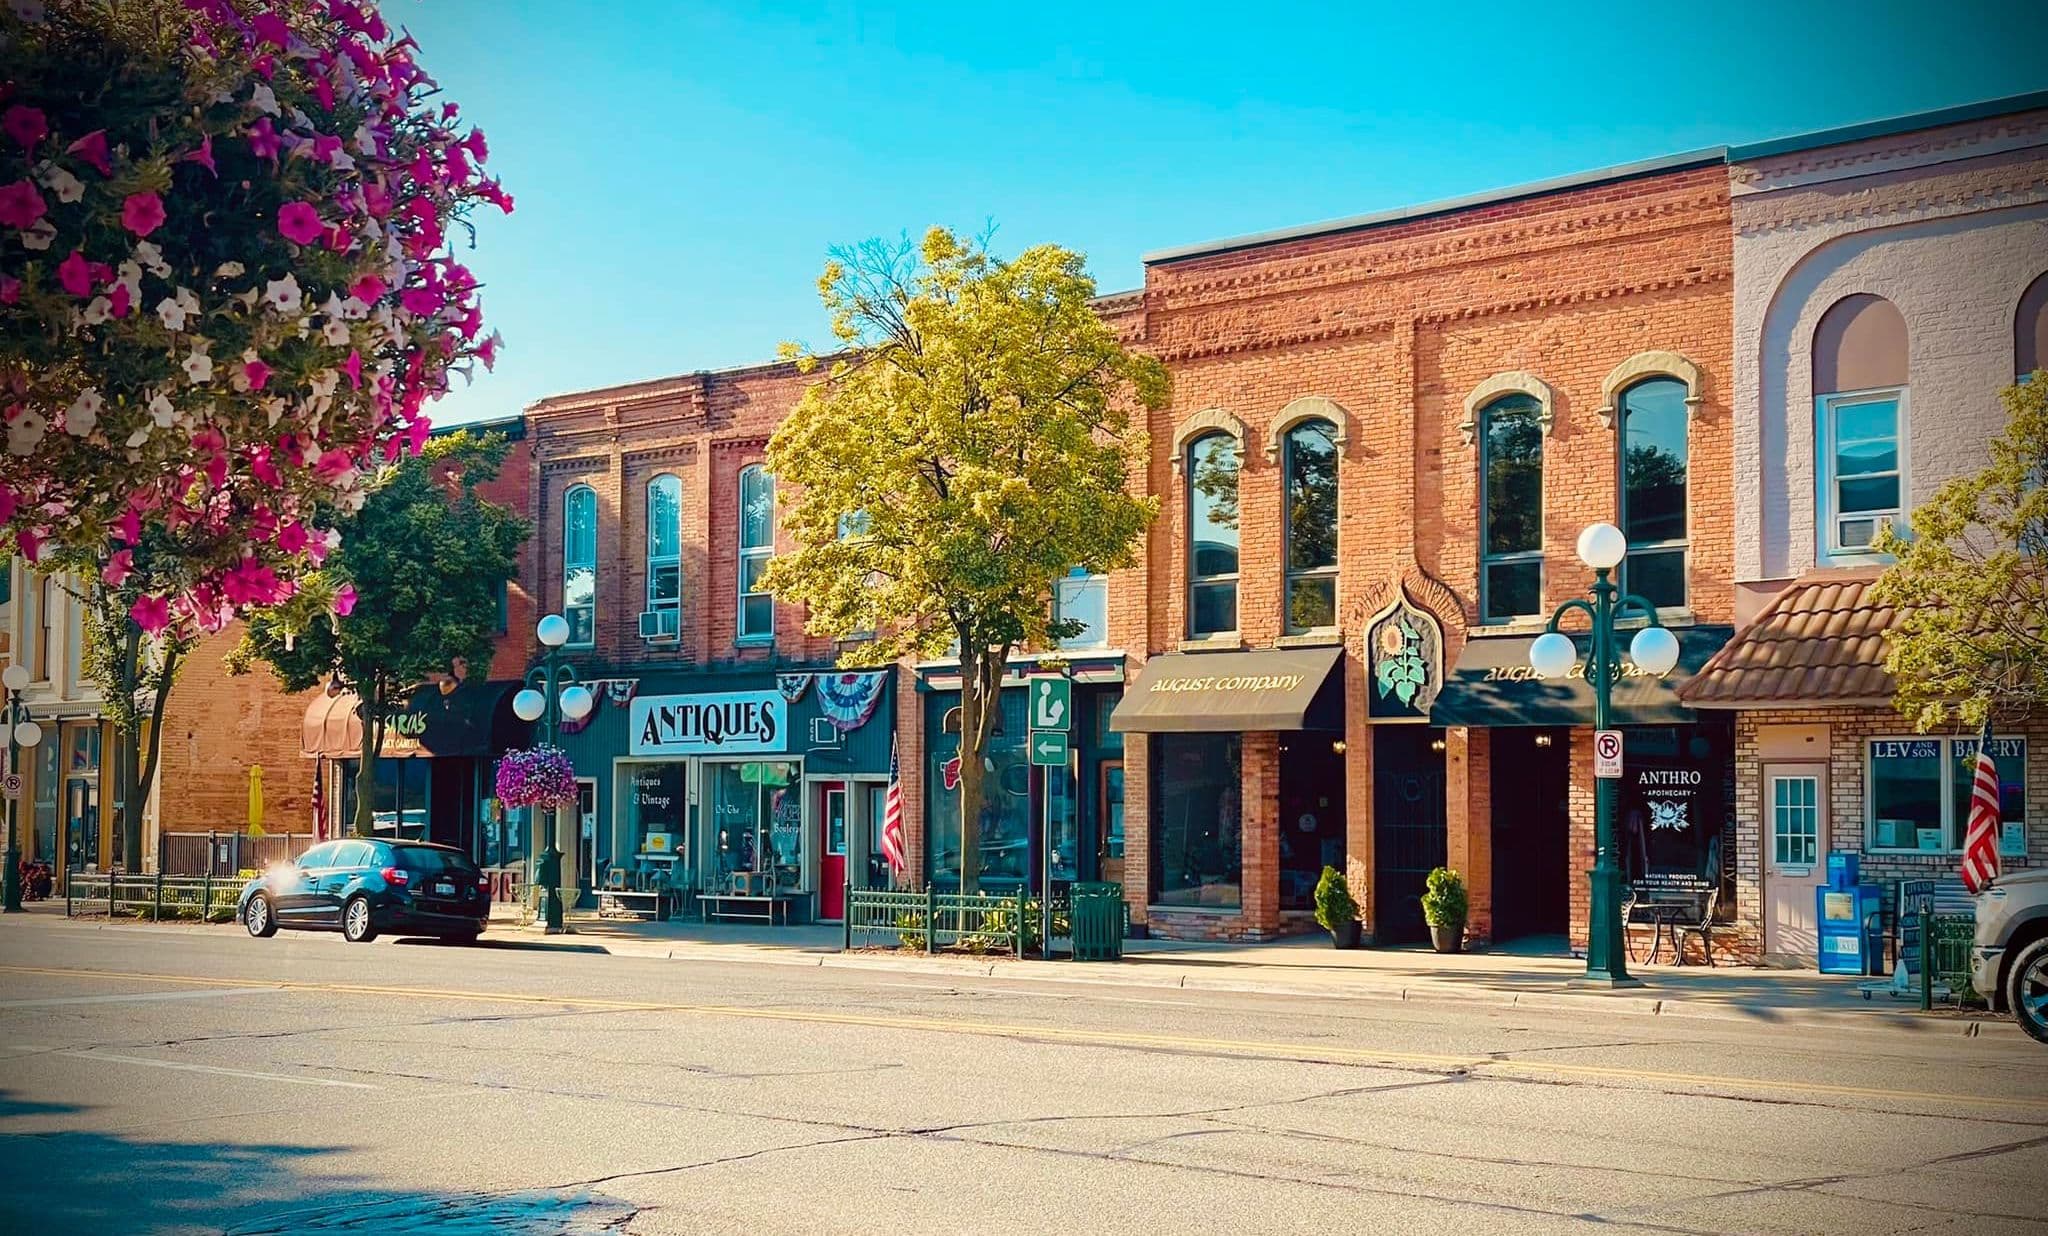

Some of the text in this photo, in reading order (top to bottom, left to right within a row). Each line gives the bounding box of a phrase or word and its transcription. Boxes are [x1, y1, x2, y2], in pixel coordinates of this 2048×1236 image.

[1483, 662, 1670, 684] augu copa
[1215, 674, 1305, 692] company
[640, 701, 776, 746] ANTIQUES
[1874, 742, 1912, 758] LEV
[1912, 748, 1937, 758] SON
[1955, 740, 2022, 758] BAERY
[1638, 770, 1702, 785] ANTHRO
[1647, 789, 1692, 797] APOTHECARY
[641, 793, 671, 810] Vintage
[1668, 873, 1698, 881] PRODUCTS
